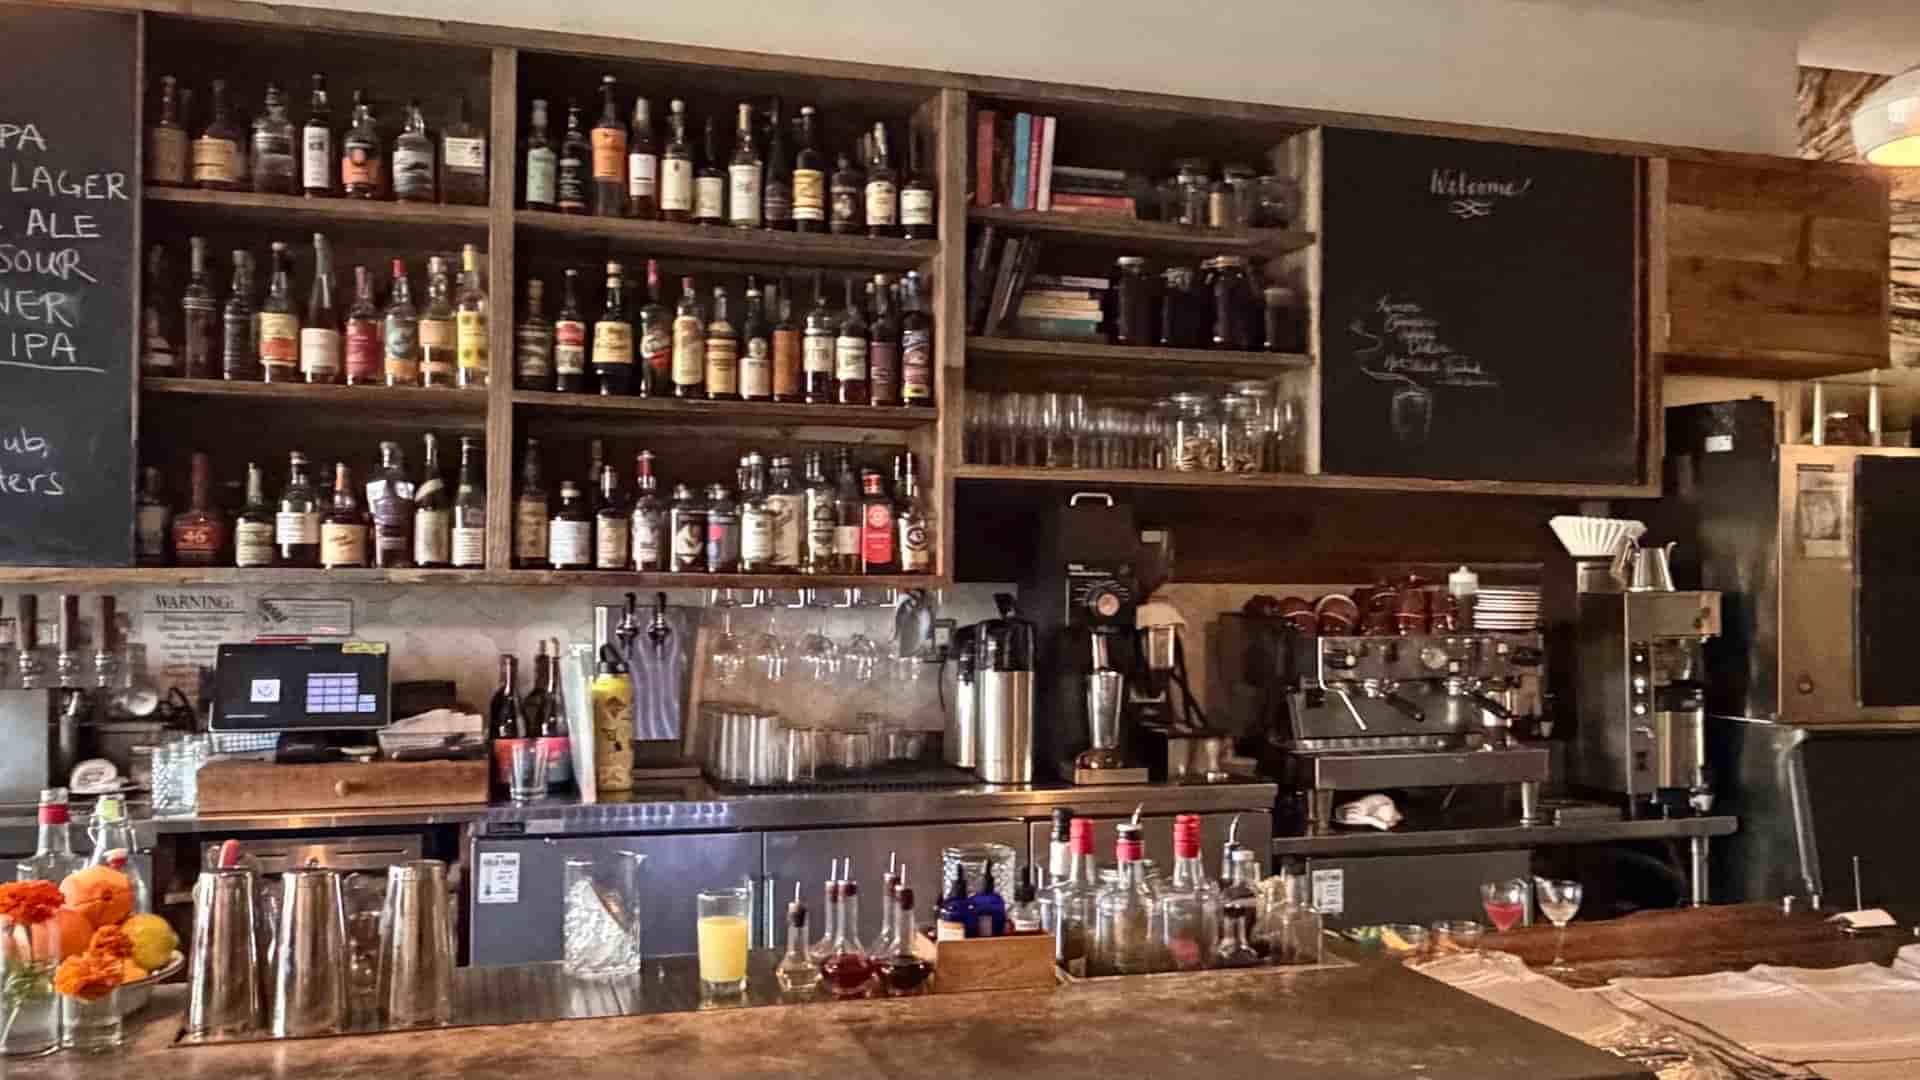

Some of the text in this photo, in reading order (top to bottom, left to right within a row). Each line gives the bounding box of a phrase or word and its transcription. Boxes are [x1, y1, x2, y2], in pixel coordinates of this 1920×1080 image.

[0, 123, 47, 151] PA
[11, 161, 129, 200] LAGER
[26, 208, 102, 238] ALE
[0, 244, 98, 283] SOUR
[11, 332, 76, 363] IPA
